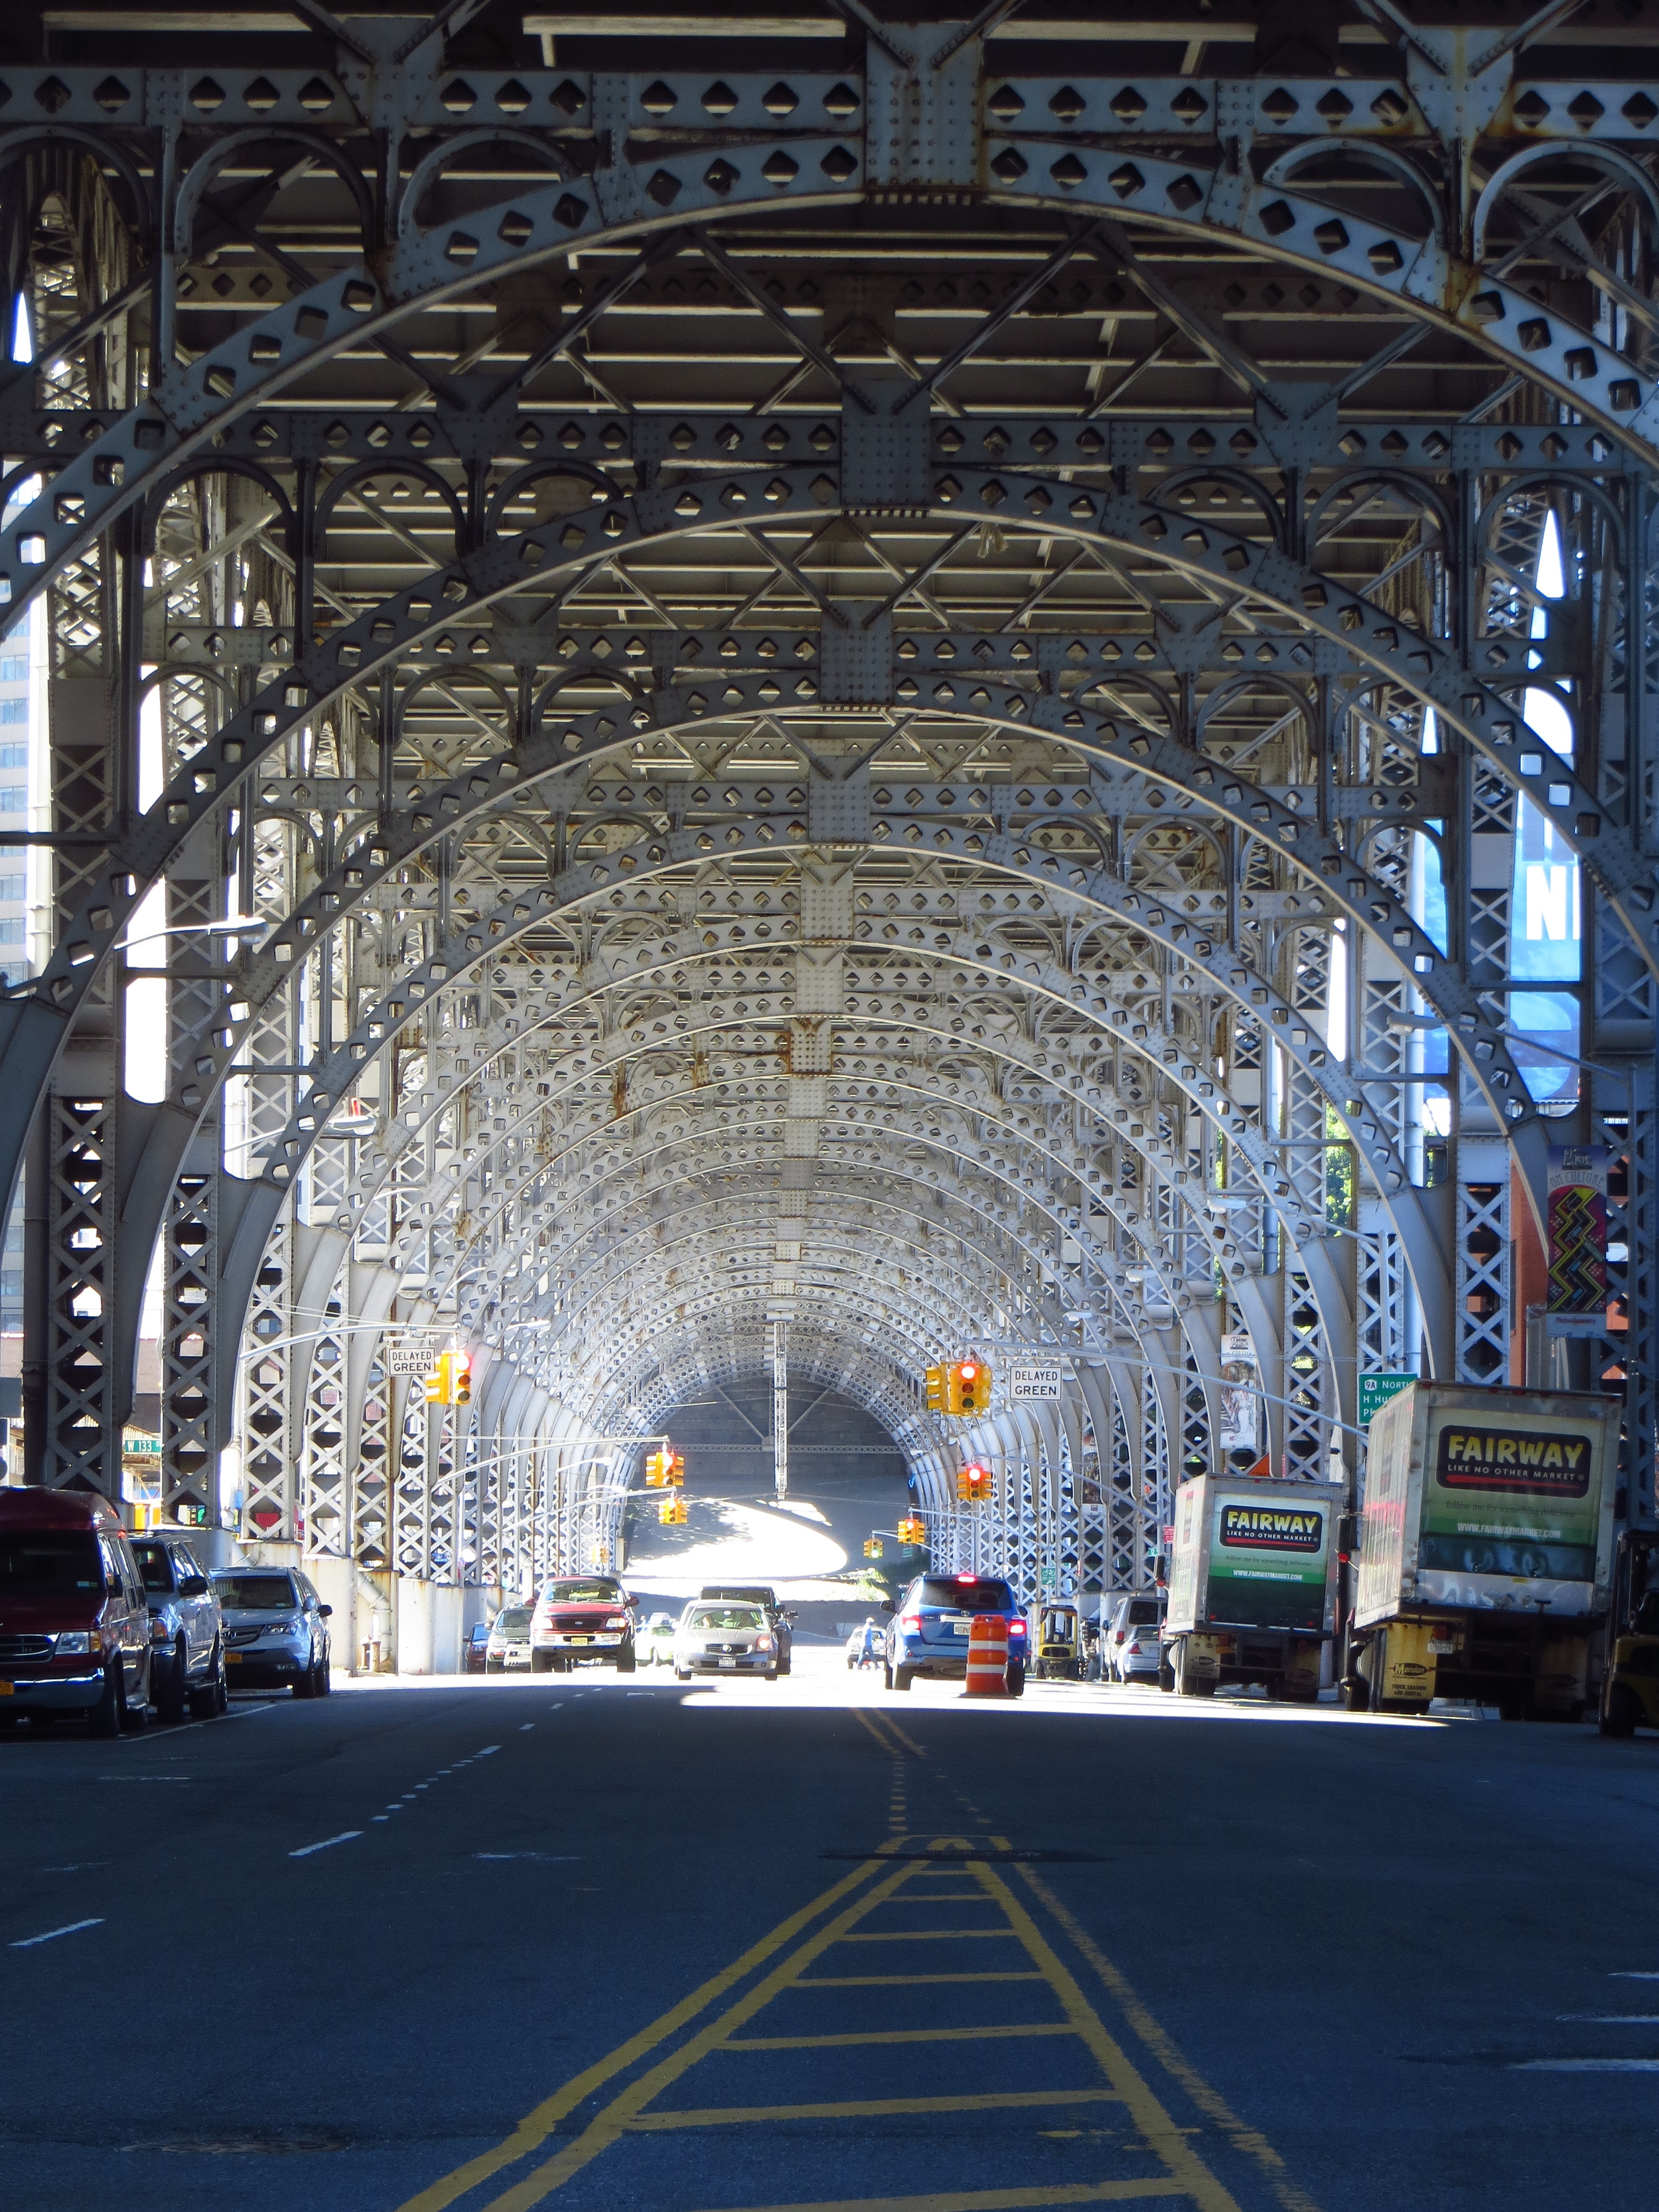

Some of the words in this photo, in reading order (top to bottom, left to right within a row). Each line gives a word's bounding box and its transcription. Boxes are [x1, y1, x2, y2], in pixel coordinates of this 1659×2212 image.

[393, 1351, 431, 1361] DELAYED
[394, 1362, 431, 1371] GREEN
[1015, 1370, 1058, 1380] DELAYED
[1015, 1385, 1056, 1395] GREEN
[1363, 1395, 1370, 1404] H
[127, 1441, 135, 1451] W
[139, 1441, 152, 1451] 133
[1449, 1435, 1584, 1469] FAIRWAY
[1494, 1468, 1528, 1477] OTHER
[1533, 1471, 1575, 1481] MARKET
[1446, 1501, 1471, 1509] follow
[1486, 1503, 1498, 1511] for
[1499, 1504, 1540, 1516] something
[1227, 1511, 1317, 1534] FAIRWAY
[1457, 1522, 1561, 1539] WWW.FAIRWAYMARKET.COM
[1261, 1557, 1288, 1566] something
[1233, 1570, 1303, 1580] WWW.FAIRWAYMARKET.COM
[1395, 1662, 1425, 1675] Mendon
